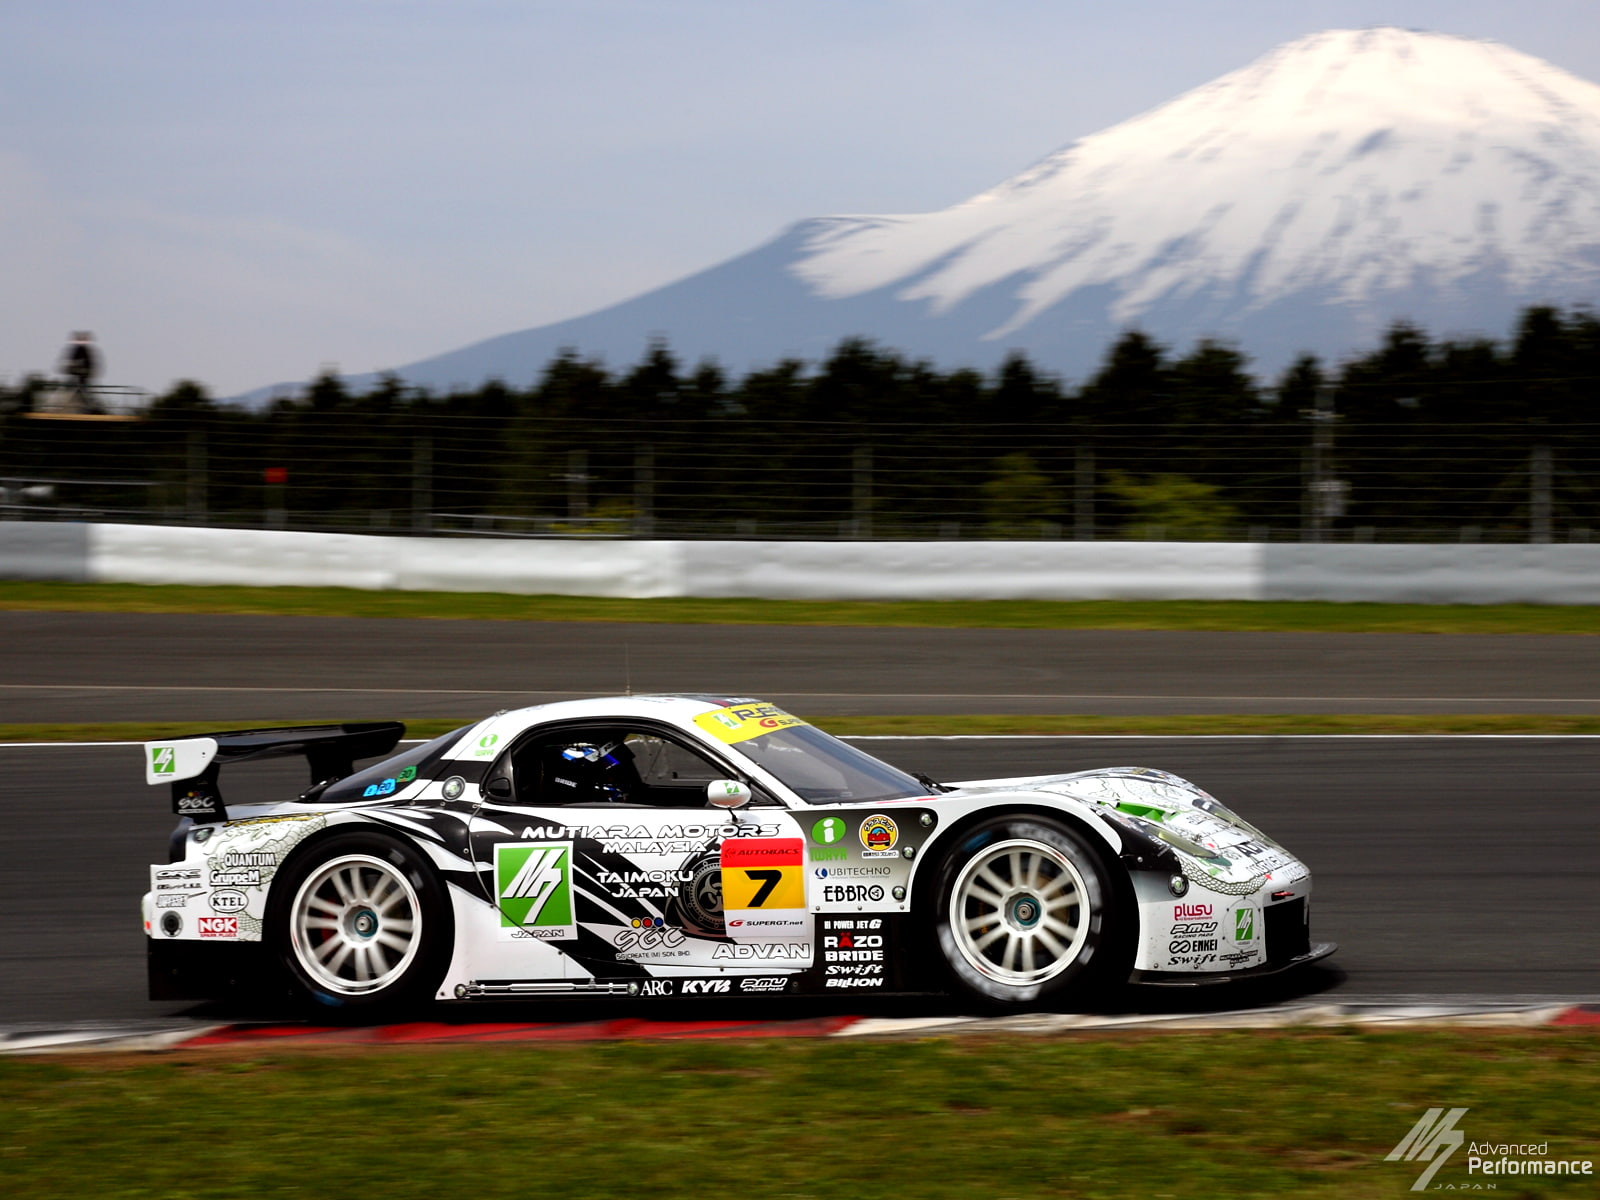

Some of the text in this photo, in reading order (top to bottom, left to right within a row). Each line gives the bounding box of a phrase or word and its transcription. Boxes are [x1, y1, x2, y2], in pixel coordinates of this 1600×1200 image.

[521, 824, 782, 839] MUTIARA MOTORS
[602, 841, 708, 856] MALAYSIA
[224, 853, 276, 867] QUANTUM
[210, 870, 260, 886] GruppeM
[597, 870, 694, 883] TAIMOKU
[829, 867, 891, 876] UBITECHNO
[610, 888, 680, 899] JAPAN
[744, 870, 782, 907] 7
[823, 885, 884, 902] EBBRO
[213, 897, 245, 907] KTEL
[200, 918, 237, 932] NGK
[833, 920, 854, 929] POWER
[511, 929, 565, 939] JAPAN
[614, 927, 686, 952] SGC
[712, 944, 810, 960] ADVAN
[1193, 939, 1218, 952] ENKEI
[825, 950, 884, 961] BRIDE
[825, 964, 884, 976] Swift
[640, 980, 673, 996] ARC
[681, 980, 731, 994] KYB
[825, 977, 884, 988] BILLION
